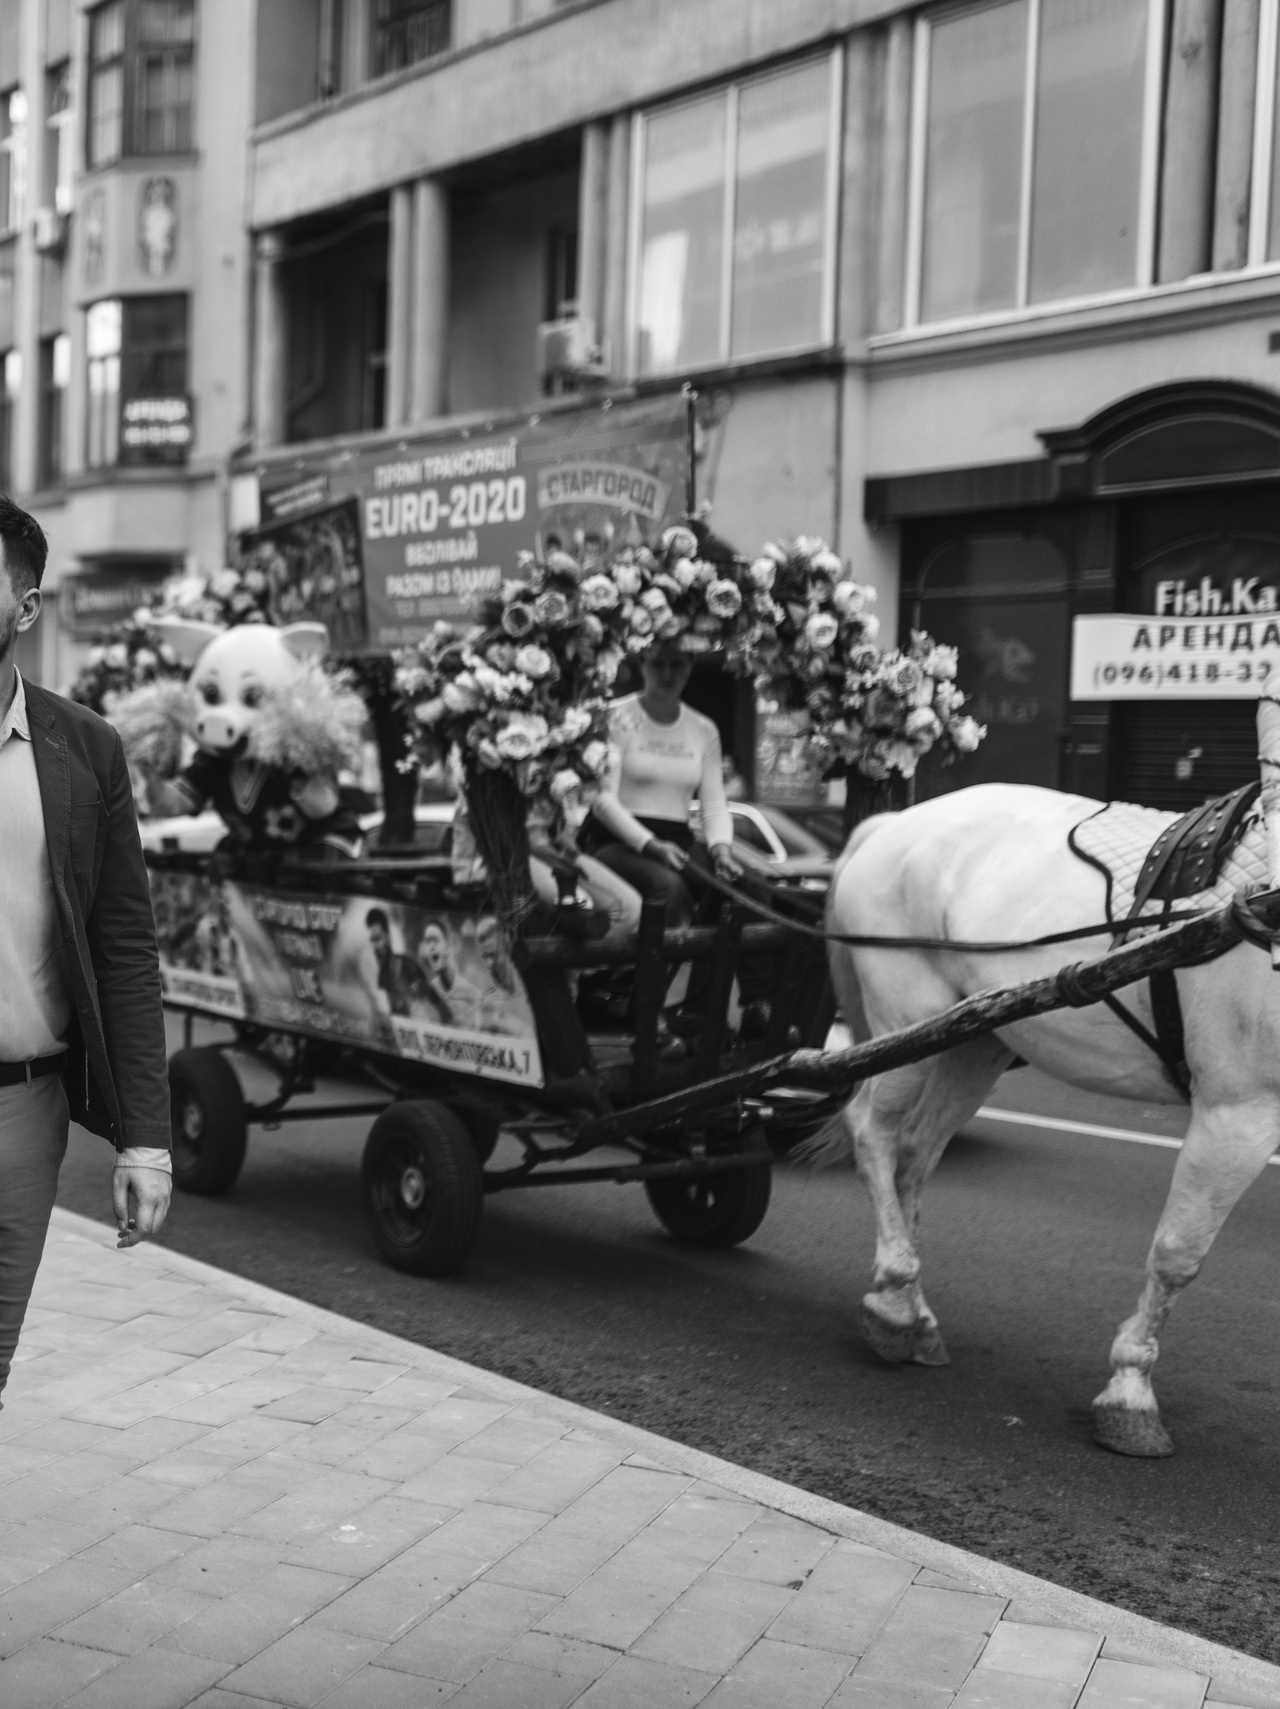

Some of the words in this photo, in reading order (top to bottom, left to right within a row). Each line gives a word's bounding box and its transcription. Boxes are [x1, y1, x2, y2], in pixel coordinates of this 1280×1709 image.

[365, 475, 527, 539] EURO-2020
[546, 468, 657, 511] СТАРГОРОД
[1155, 575, 1279, 616] Fish.Ka
[1132, 622, 1280, 654] АРЕНДА
